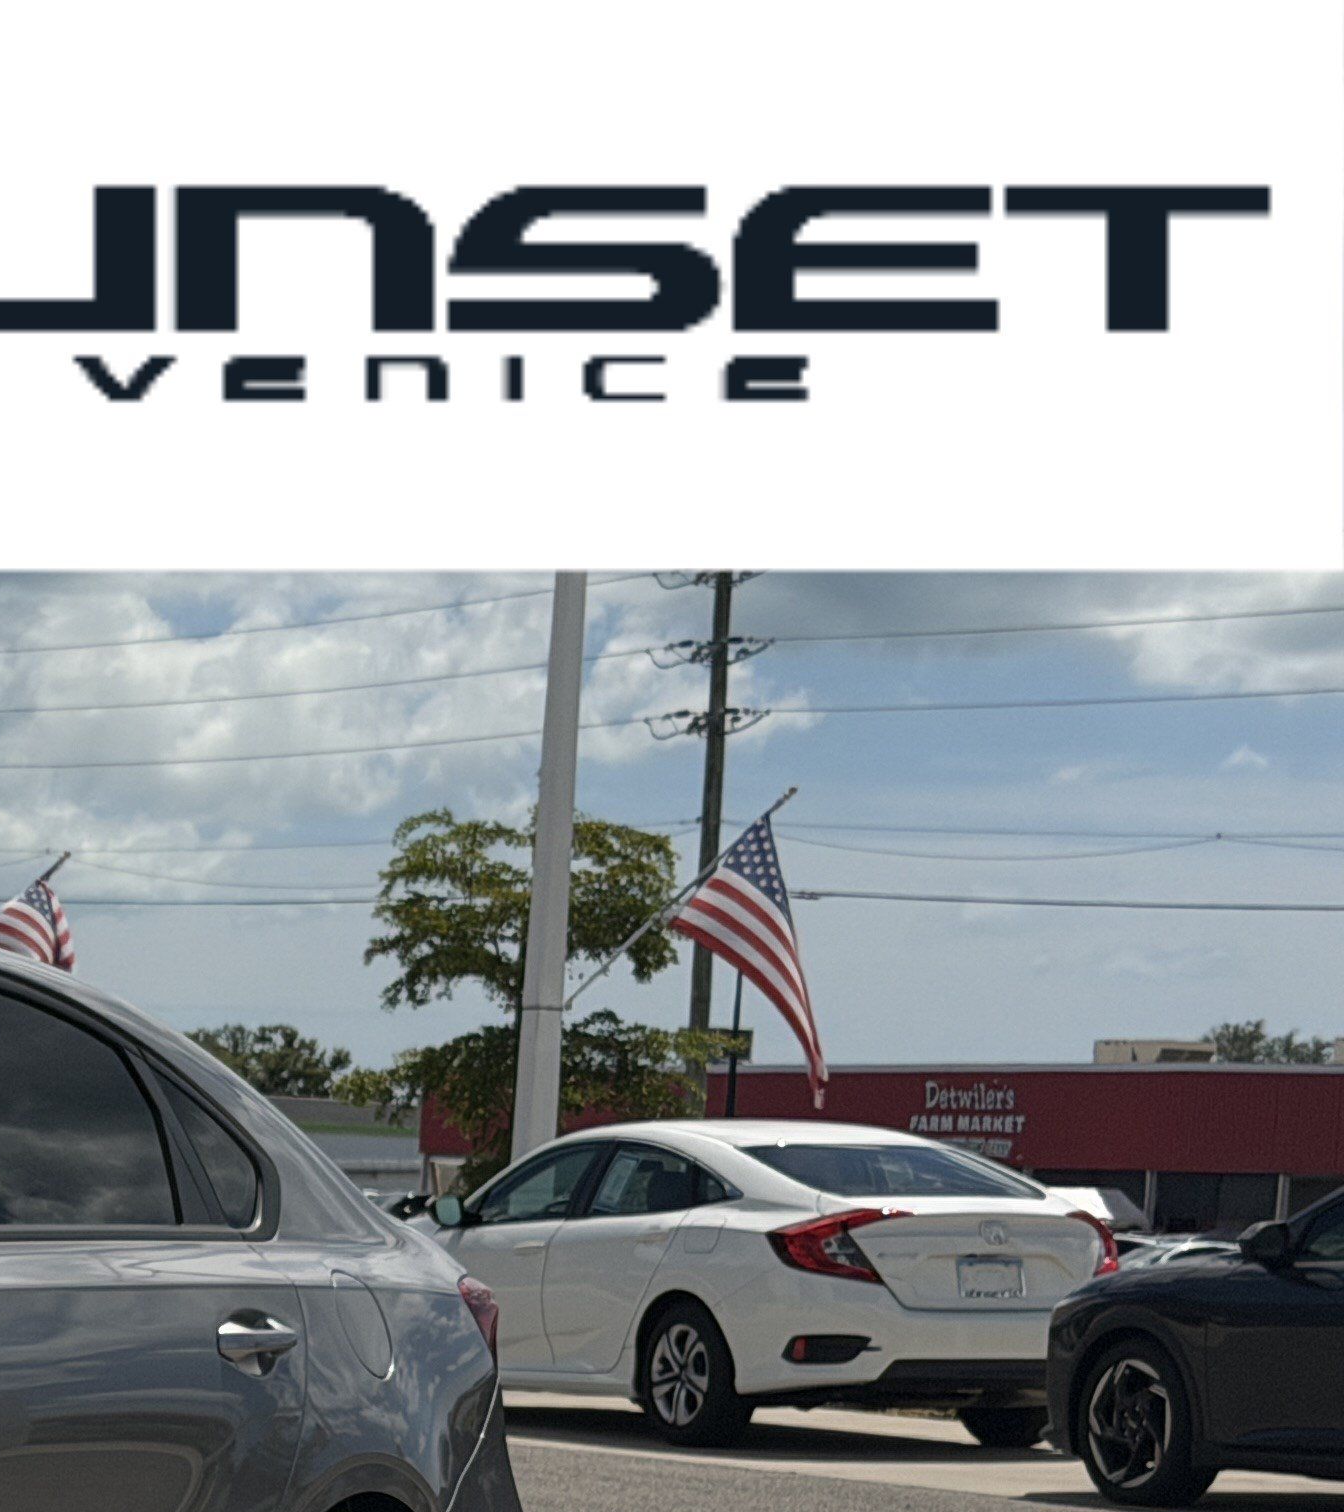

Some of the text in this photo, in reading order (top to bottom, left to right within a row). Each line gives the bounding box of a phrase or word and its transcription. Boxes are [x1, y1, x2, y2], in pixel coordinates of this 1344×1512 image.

[925, 1080, 1015, 1110] Detwiler's
[909, 1115, 1025, 1133] FARM MARKET
